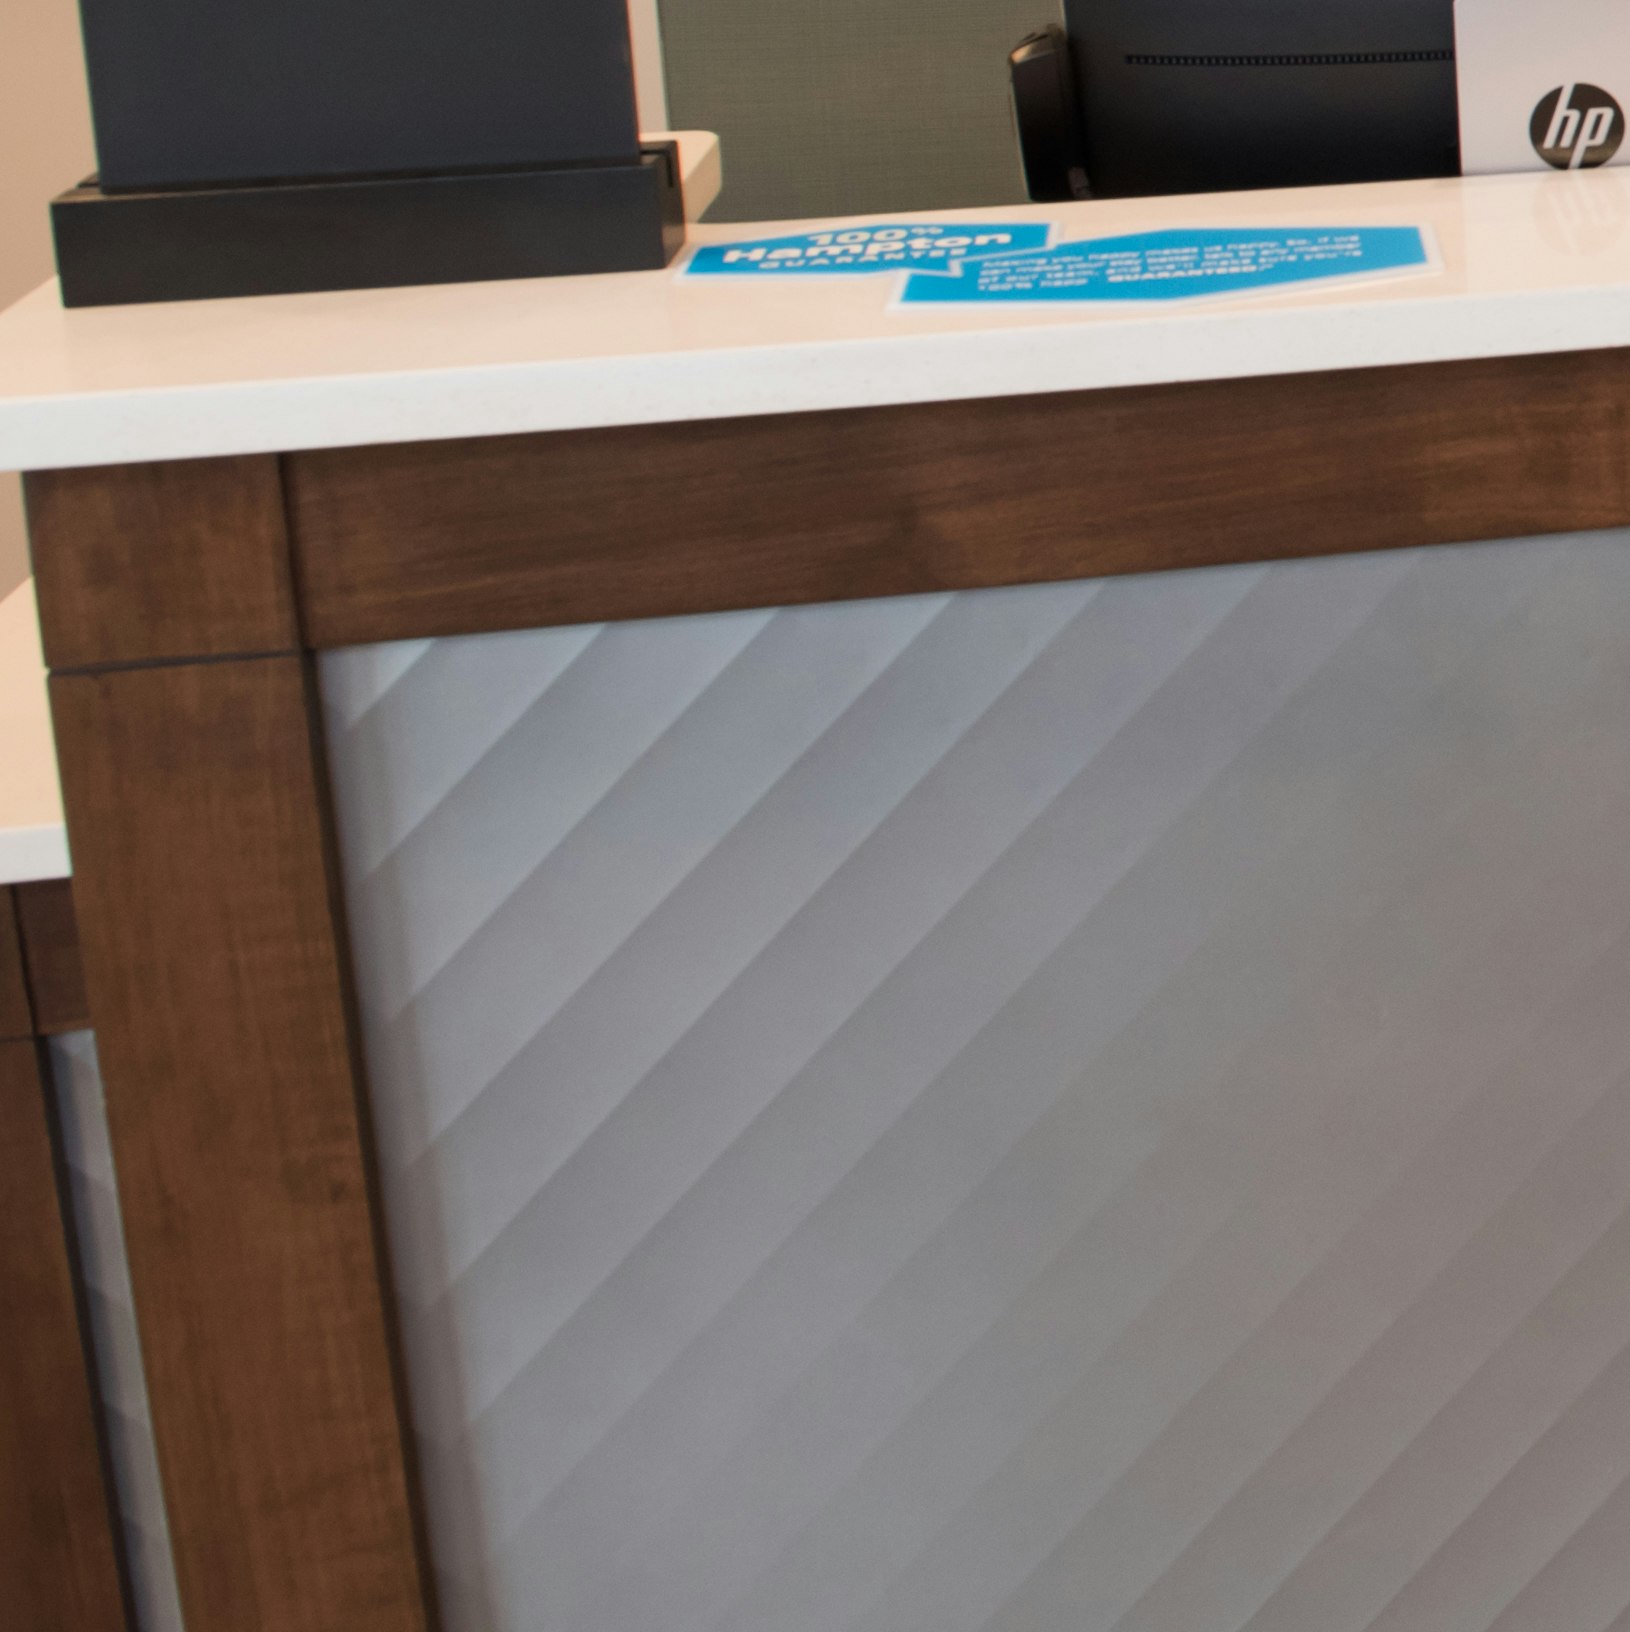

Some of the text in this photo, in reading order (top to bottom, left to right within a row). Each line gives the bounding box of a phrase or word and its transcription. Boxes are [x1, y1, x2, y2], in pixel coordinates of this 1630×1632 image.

[1540, 83, 1616, 169] hp
[722, 233, 1012, 264] Hampton
[807, 226, 944, 245] 100%
[758, 248, 967, 270] GUARANTEE
